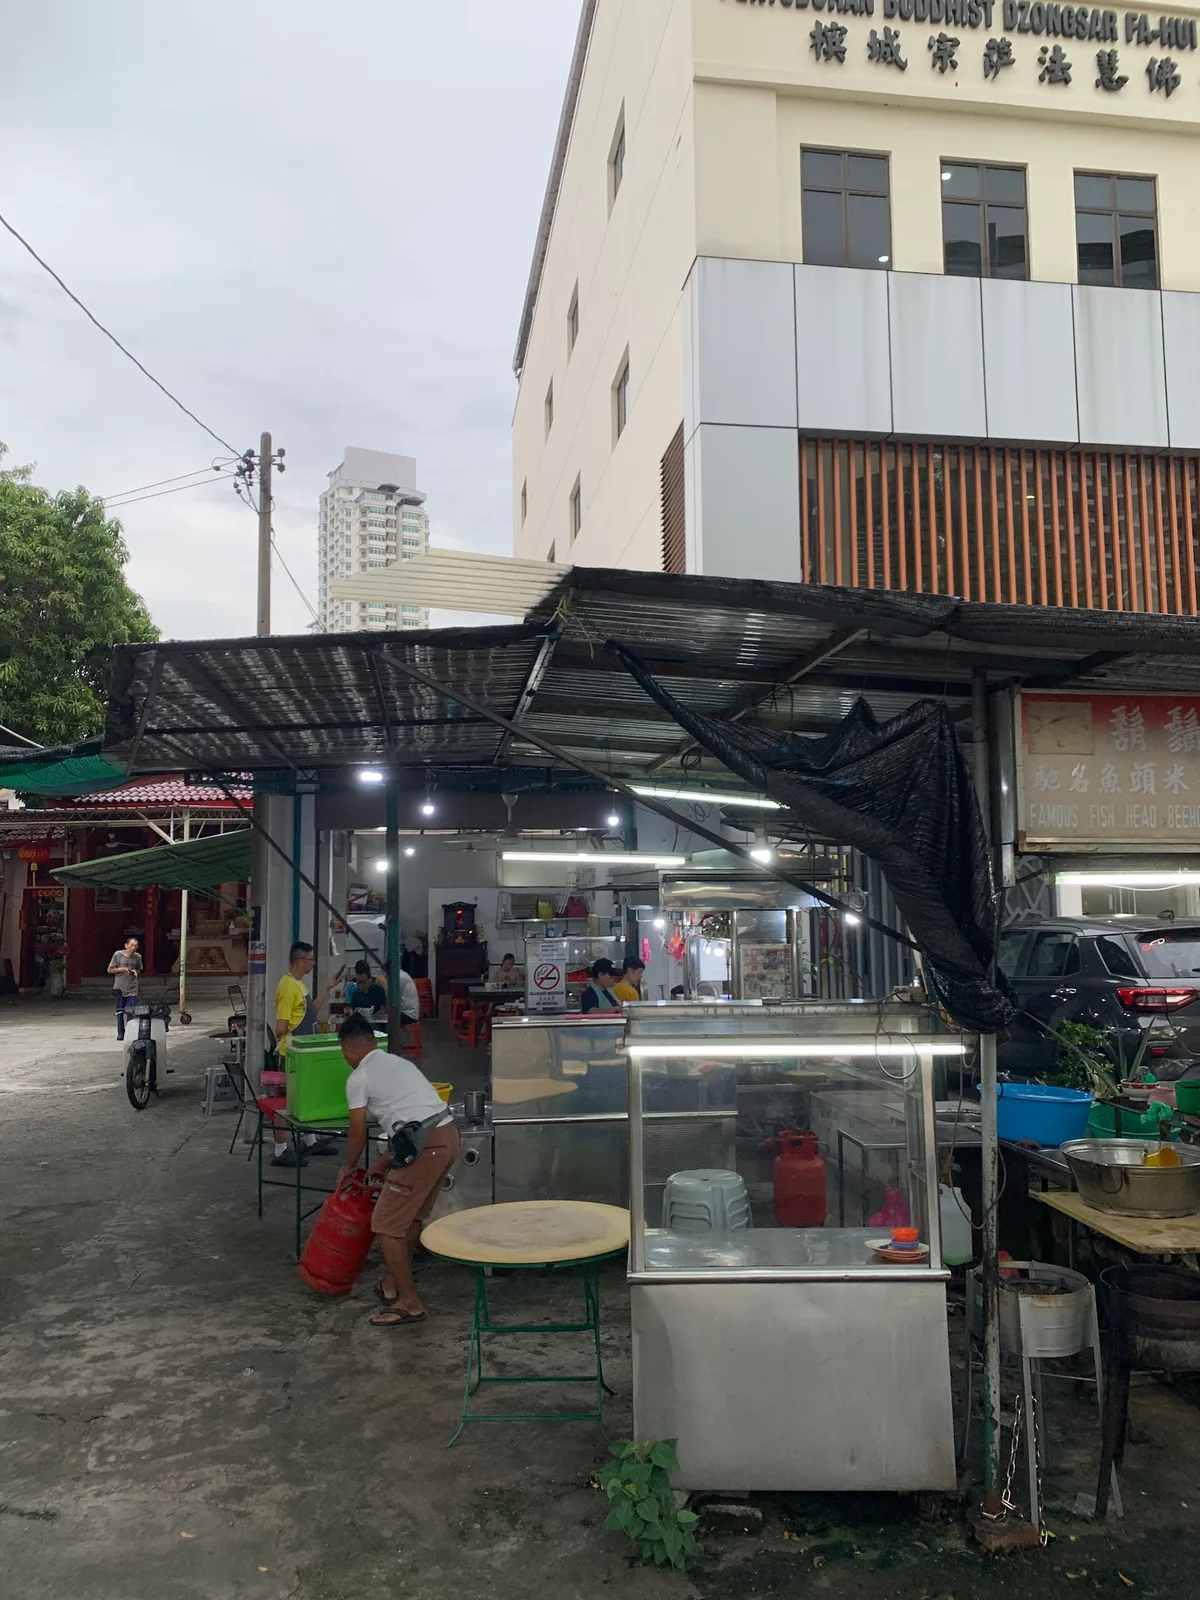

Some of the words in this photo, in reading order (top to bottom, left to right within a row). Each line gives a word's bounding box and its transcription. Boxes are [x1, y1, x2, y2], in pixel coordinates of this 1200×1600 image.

[1002, 1, 1118, 41] DZONGSAR
[1125, 12, 1198, 50] FA-HUI
[1033, 763, 1200, 796] 馳名魚頭米
[1030, 803, 1078, 829] FAMOUS
[1089, 803, 1115, 829] FISH
[1125, 804, 1157, 829] HEAD
